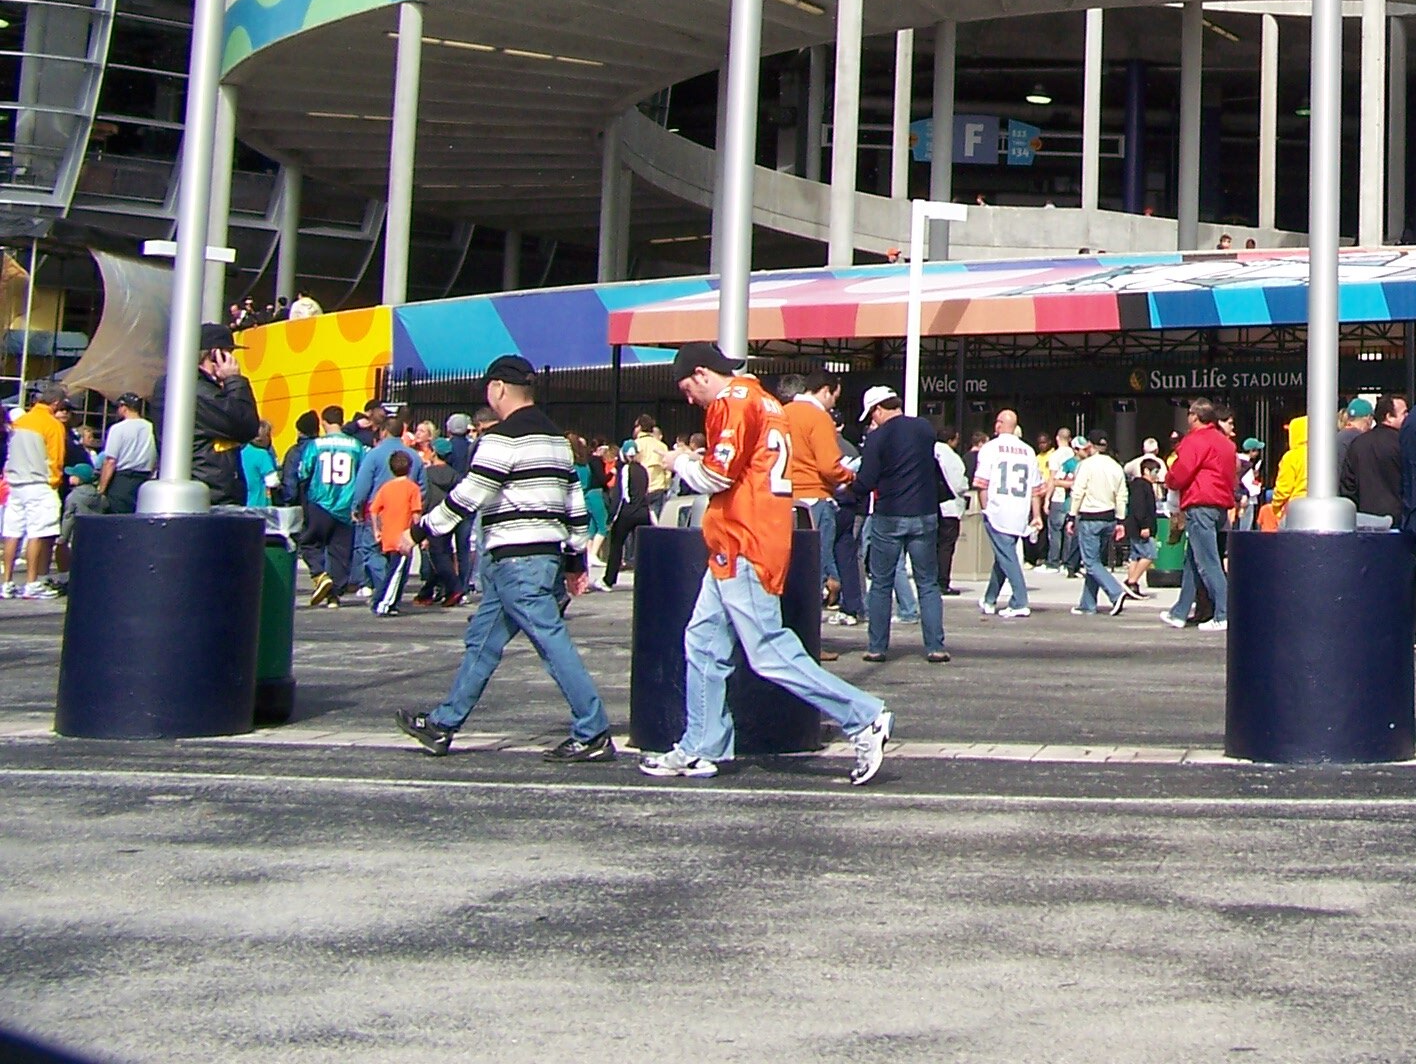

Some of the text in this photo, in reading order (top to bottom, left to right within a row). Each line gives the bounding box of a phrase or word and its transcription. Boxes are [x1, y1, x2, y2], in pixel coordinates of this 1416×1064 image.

[964, 123, 984, 156] F
[920, 374, 988, 392] Welcme
[1150, 368, 1303, 388] Sun Life STADIUM
[318, 451, 352, 484] 19
[997, 462, 1029, 498] 13
